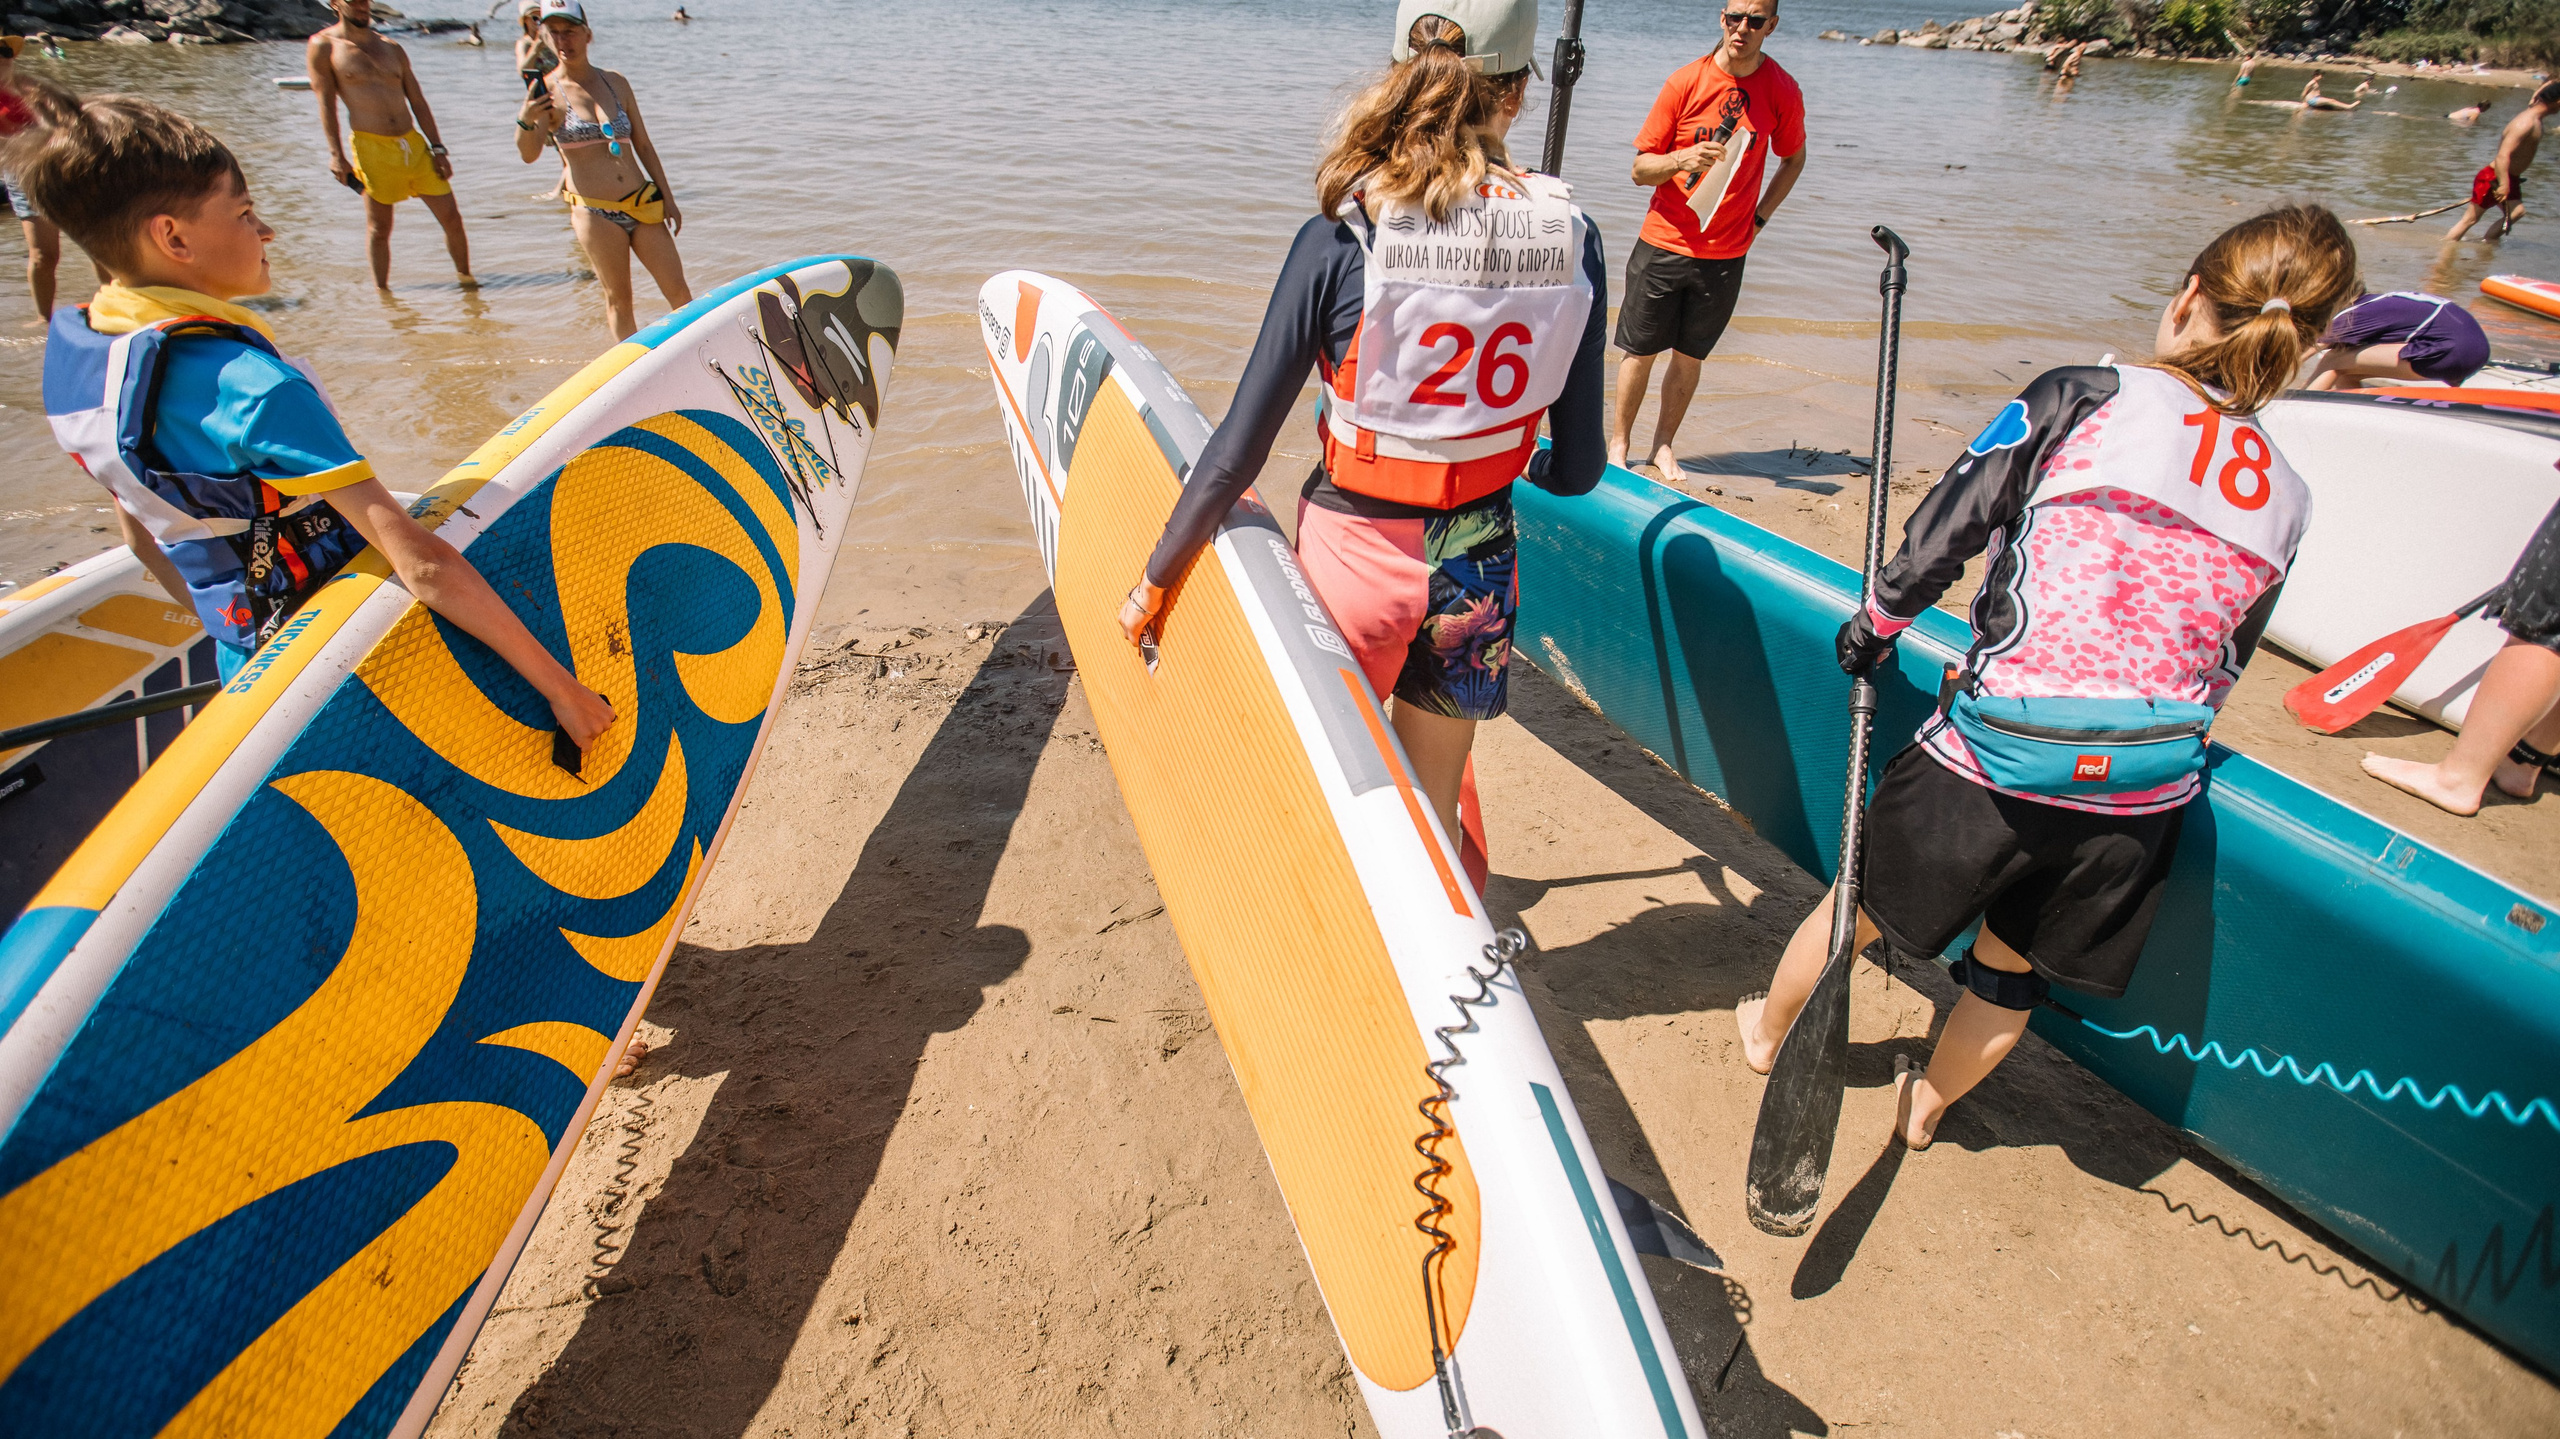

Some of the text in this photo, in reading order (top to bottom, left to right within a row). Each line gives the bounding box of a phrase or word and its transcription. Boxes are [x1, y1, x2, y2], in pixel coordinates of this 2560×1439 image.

[1385, 245, 1565, 273] ШКОЛА ПАРУСНОГО СПОРТА
[1408, 321, 1533, 409] 26
[2183, 405, 2272, 511] 18
[163, 611, 200, 627] ELITE
[1267, 538, 1328, 626] GLADIATOR
[226, 609, 322, 694] THICKNESS
[2078, 756, 2108, 775] red
